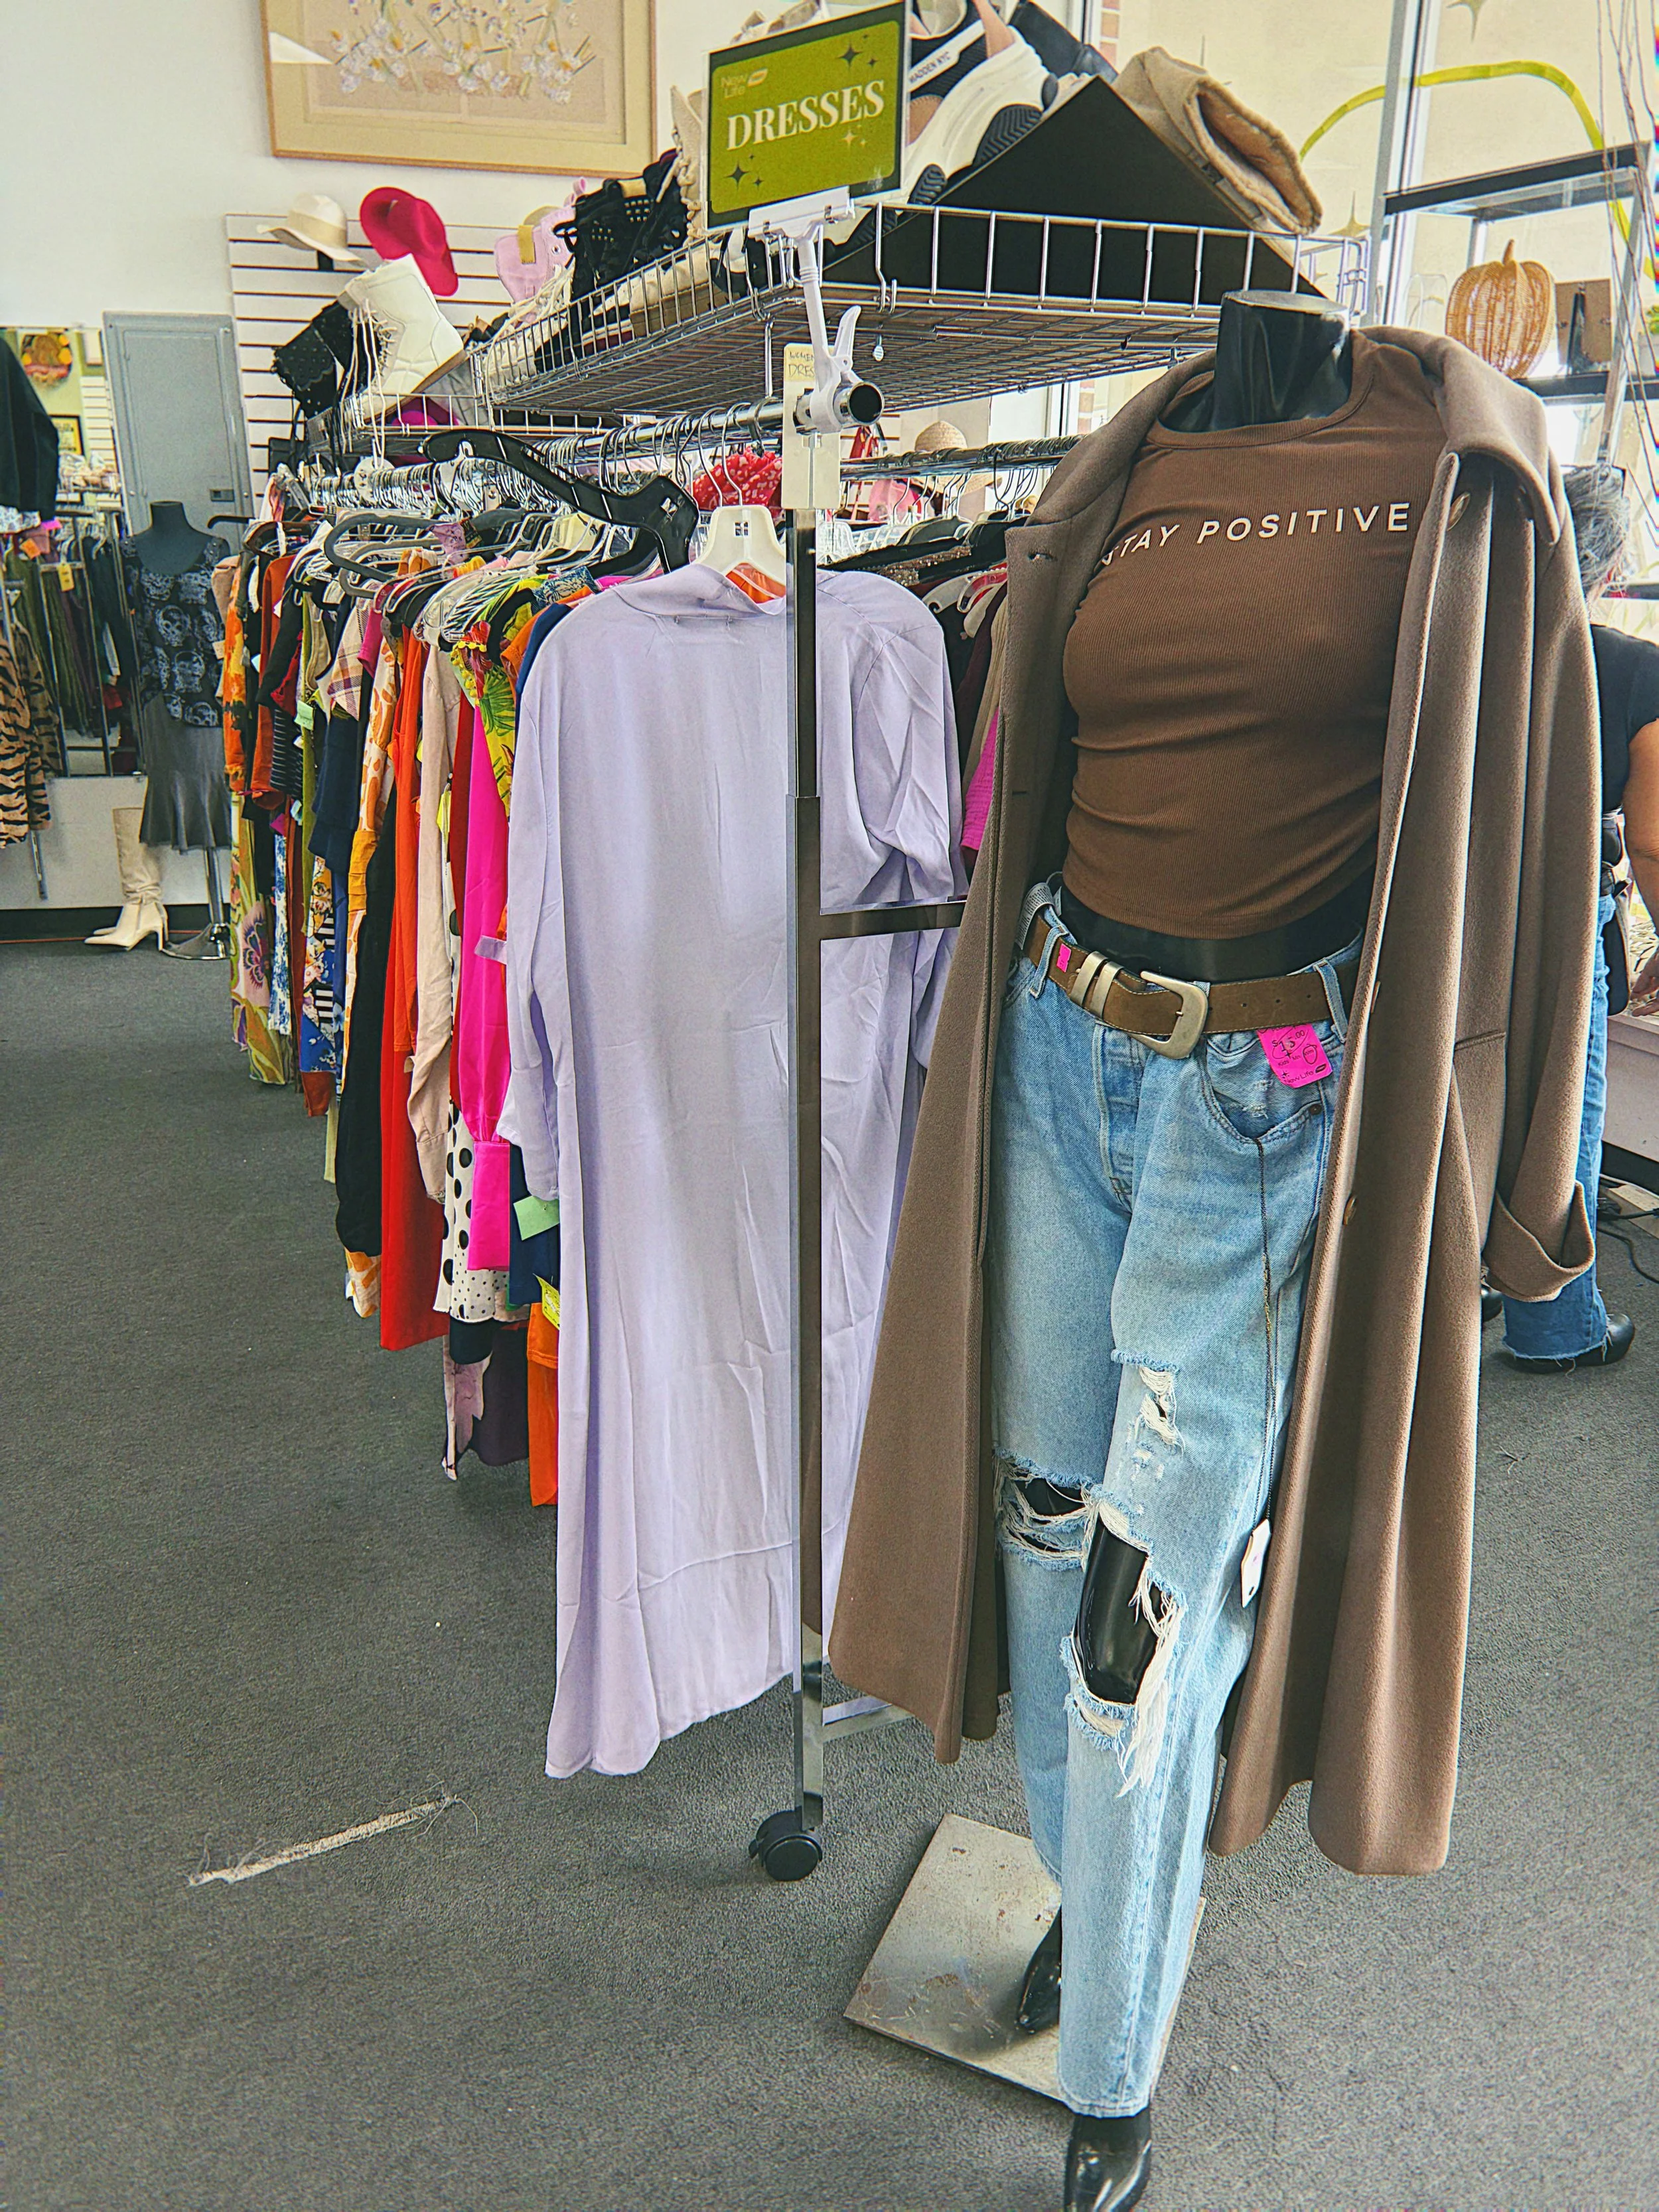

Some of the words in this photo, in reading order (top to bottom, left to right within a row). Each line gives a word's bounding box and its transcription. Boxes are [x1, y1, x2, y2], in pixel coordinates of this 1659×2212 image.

[721, 74, 747, 88] New
[724, 86, 746, 98] Life
[727, 80, 884, 151] DRESSES
[1196, 502, 1410, 544] POSITIVE
